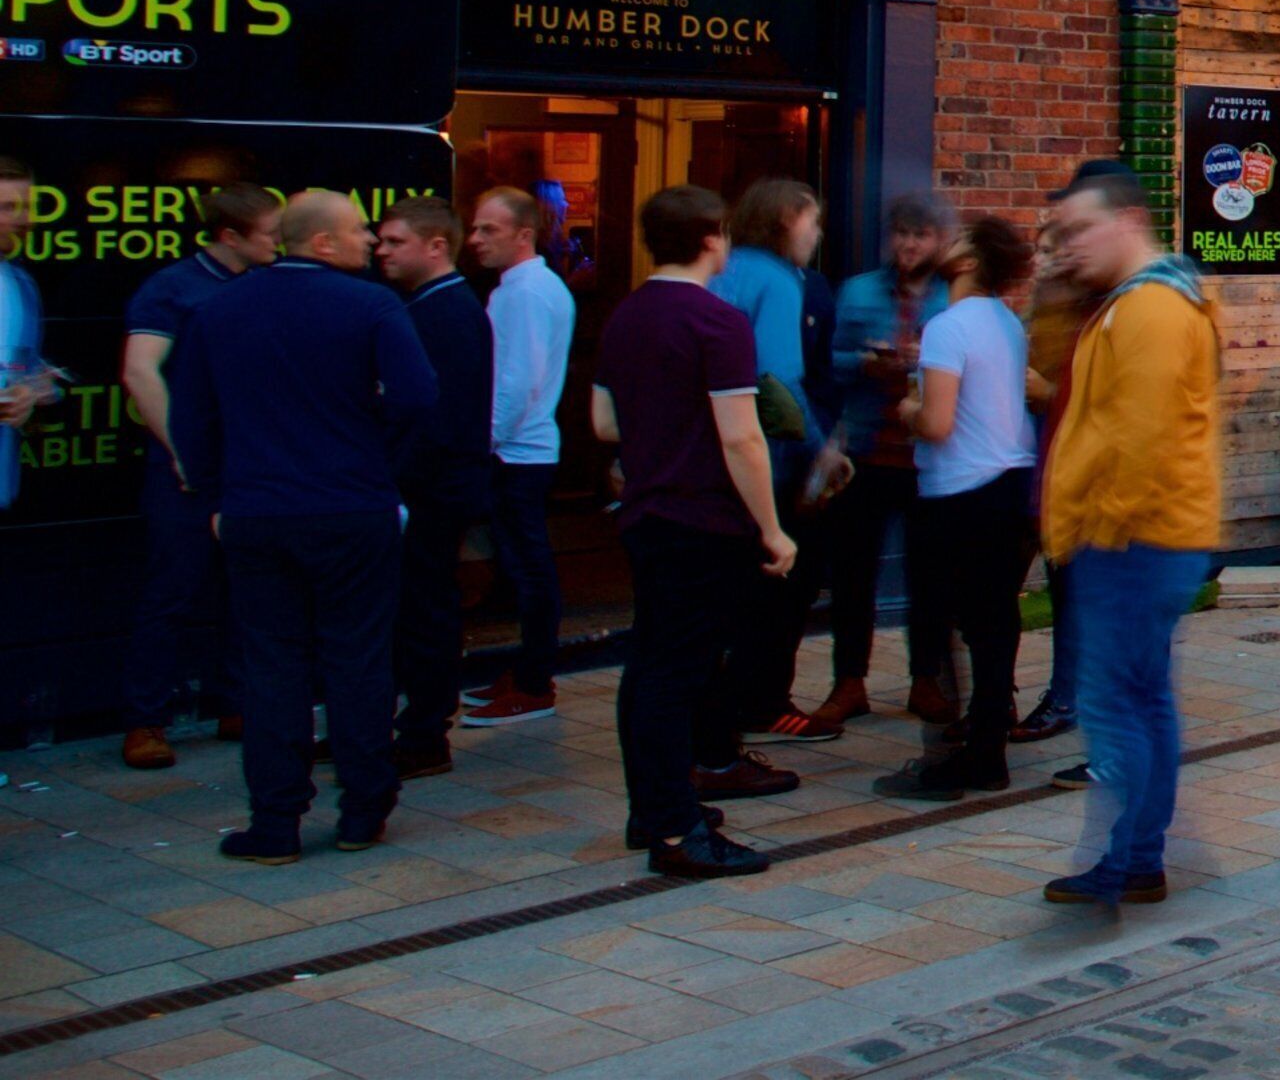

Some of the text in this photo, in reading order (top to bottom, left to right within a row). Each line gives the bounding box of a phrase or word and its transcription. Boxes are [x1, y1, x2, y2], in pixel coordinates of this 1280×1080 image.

[513, 4, 771, 42] HUMBER DOCK
[11, 44, 38, 56] HD
[80, 44, 117, 60] BT
[119, 45, 182, 65] Sport
[535, 33, 753, 56] BAR AND GRILL HULL
[1214, 96, 1267, 107] HUMBER DOCK
[1208, 103, 1271, 122] tavern
[96, 231, 181, 260] FOR
[1192, 231, 1237, 250] REAL
[1201, 249, 1276, 262] SERVED HERE
[20, 434, 117, 468] ABLE
